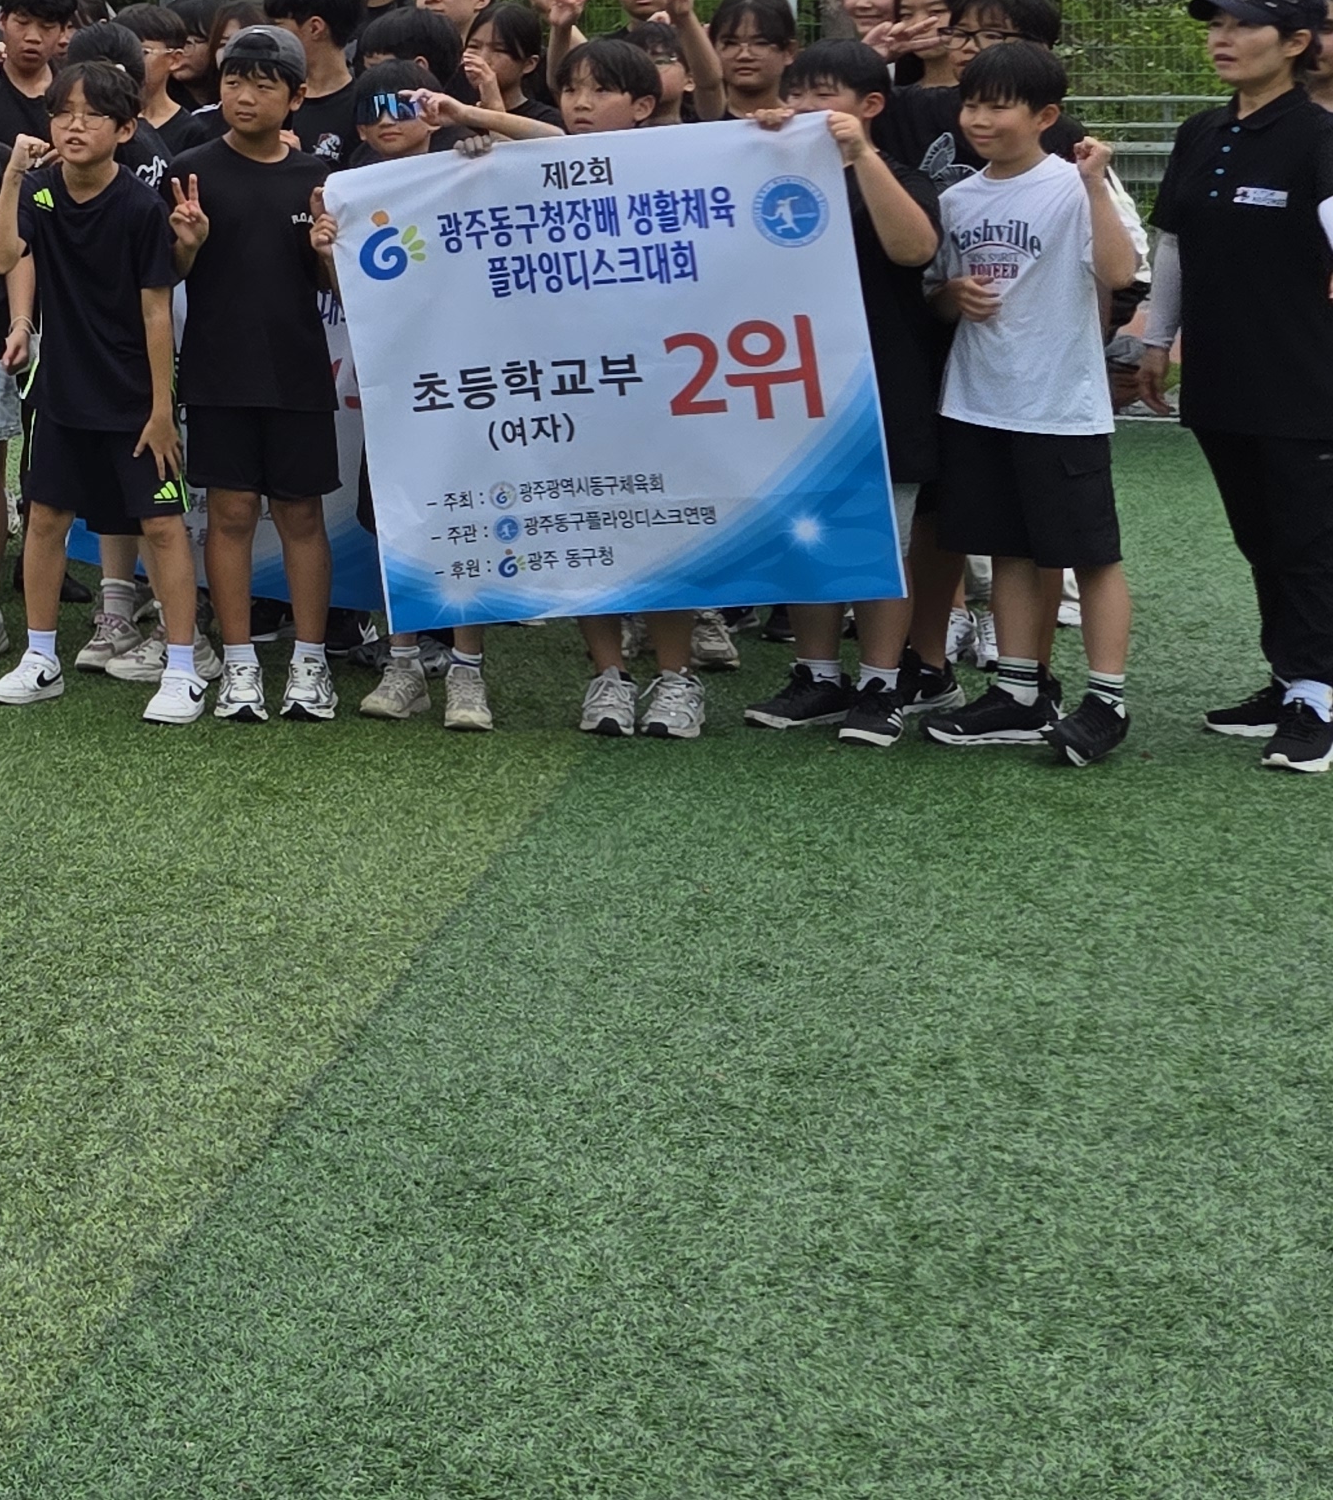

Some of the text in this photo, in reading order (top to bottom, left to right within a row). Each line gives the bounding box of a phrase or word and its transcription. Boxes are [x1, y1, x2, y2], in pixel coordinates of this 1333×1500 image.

[540, 156, 615, 191] 제2회
[436, 197, 622, 255] 광주동구청장배
[627, 185, 737, 238] 생활체육
[487, 240, 700, 299] 플라잉디스크대회
[411, 313, 826, 421] 초등학교부 2위
[488, 412, 576, 452] (여자)
[519, 473, 666, 505] 광주광역시동구체육회
[523, 505, 717, 538] 광주동구플라잉디스크연맹
[527, 549, 560, 573] 광주
[564, 546, 615, 569] 동구청
